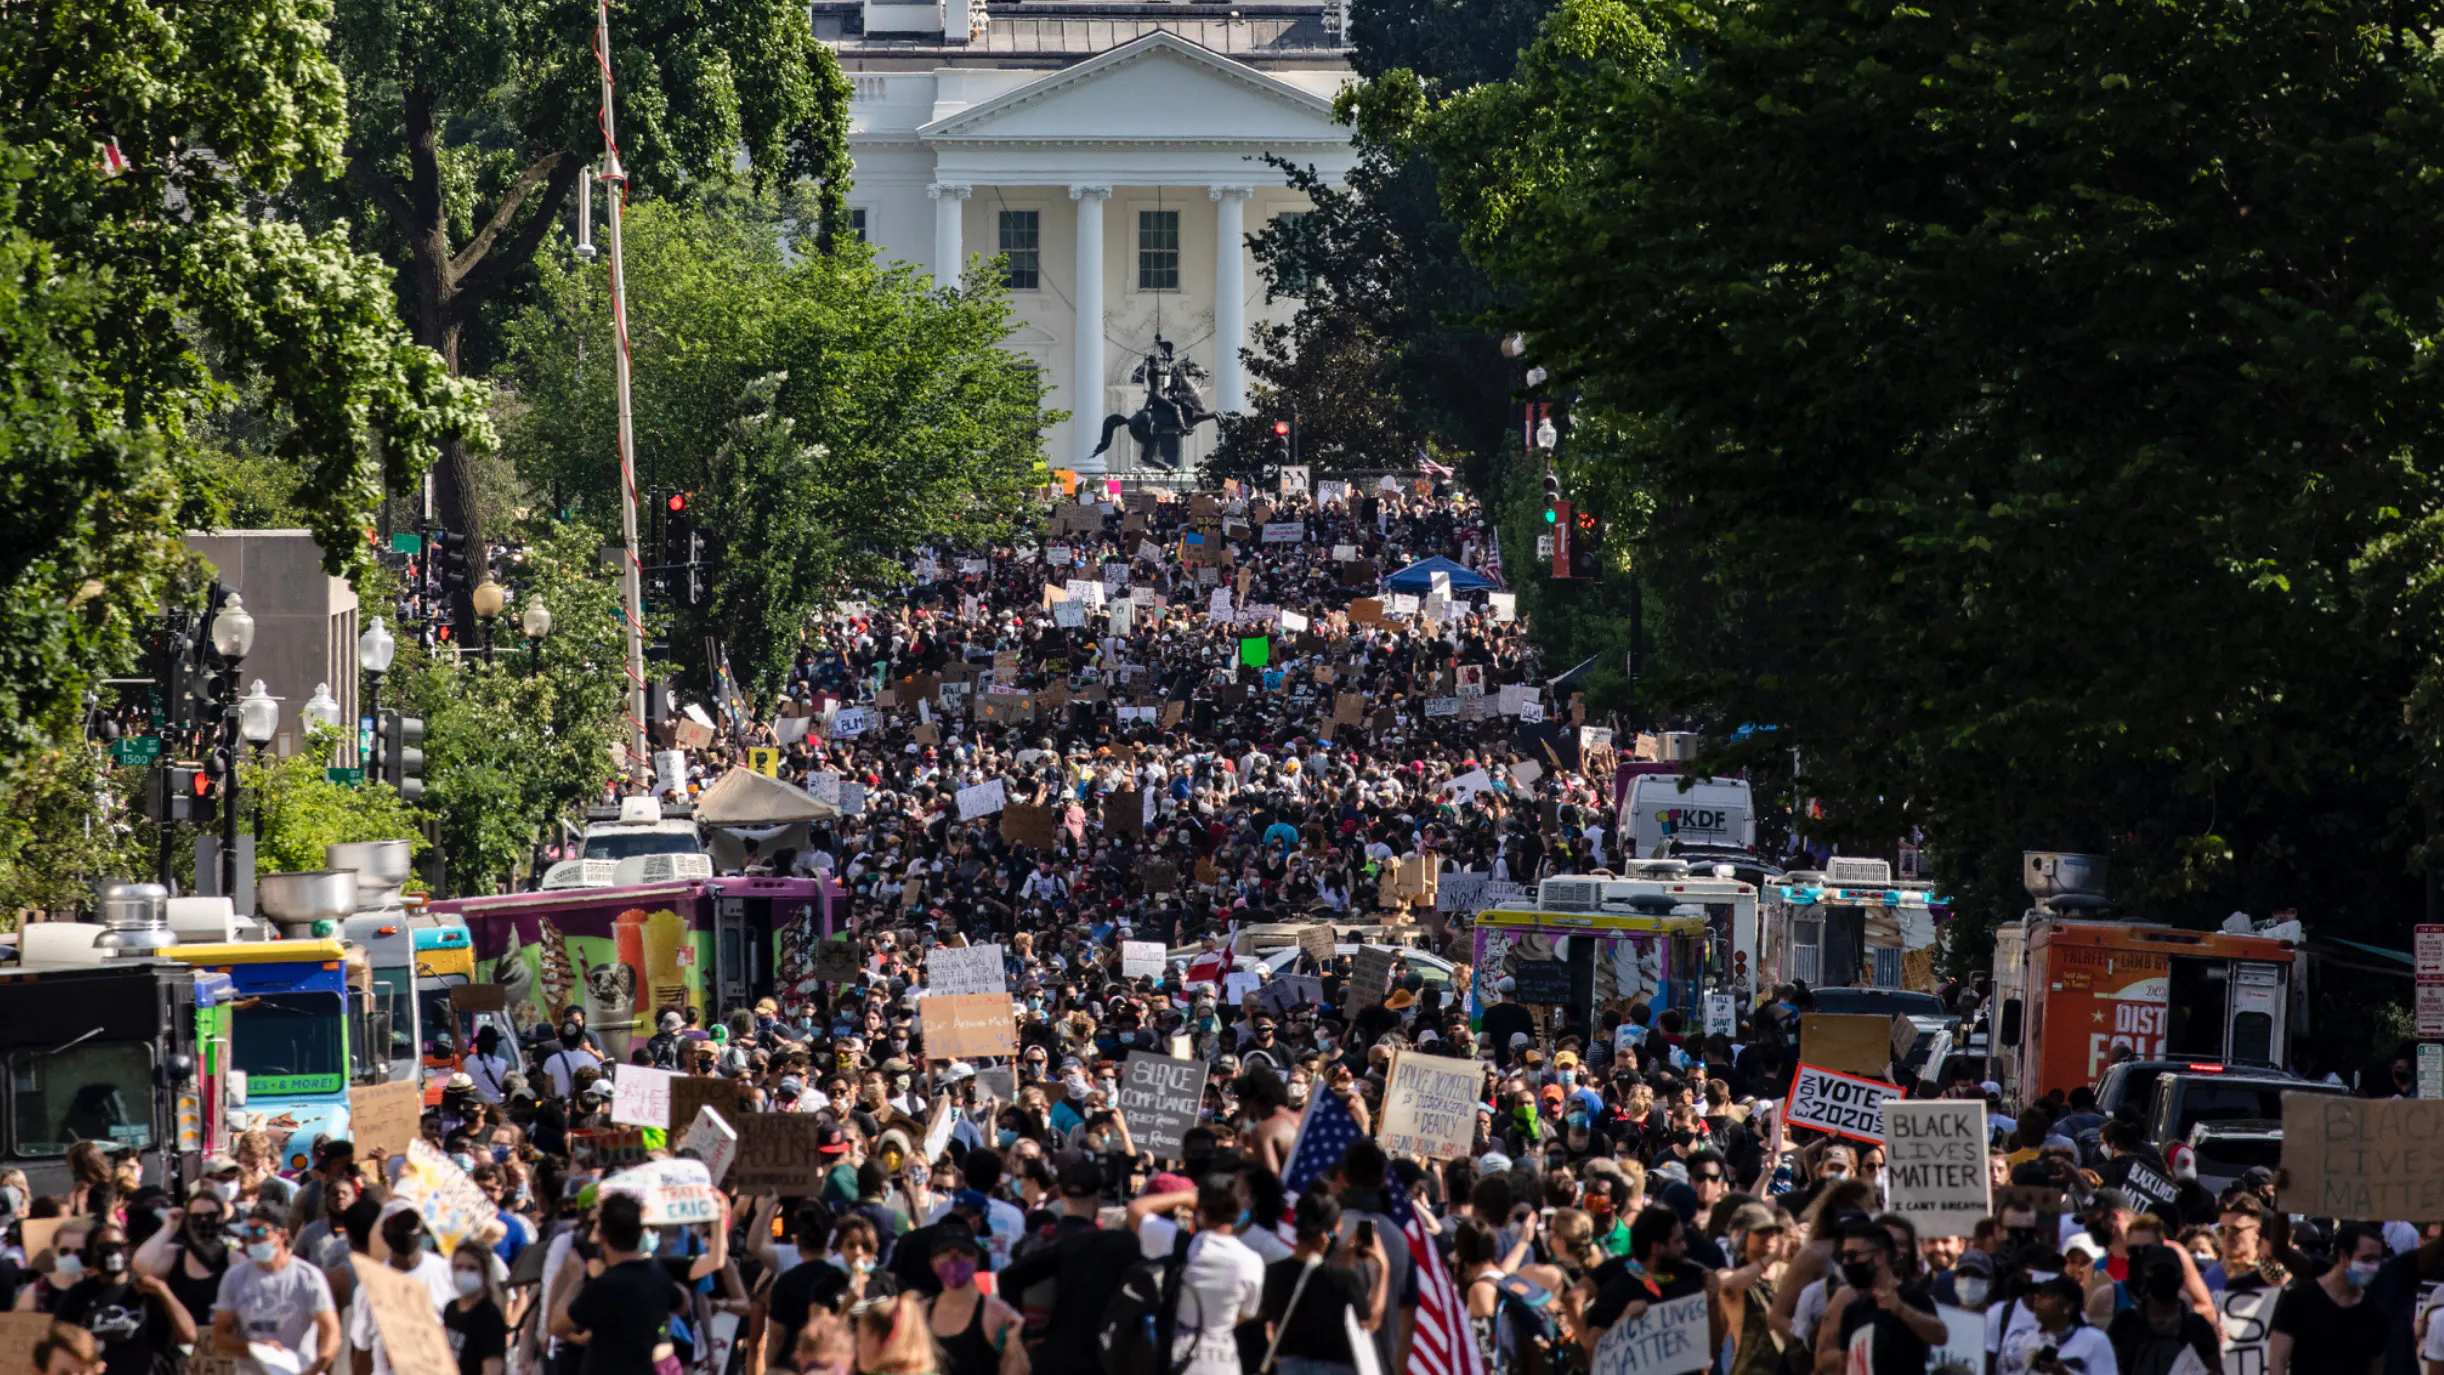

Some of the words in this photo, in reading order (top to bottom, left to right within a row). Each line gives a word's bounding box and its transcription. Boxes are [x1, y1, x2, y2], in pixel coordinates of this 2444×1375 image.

[1523, 705, 1541, 716] BLM
[841, 716, 865, 732] BLM
[123, 738, 132, 752] L
[123, 754, 149, 765] 1500
[1682, 809, 1726, 828] KDF
[2121, 953, 2151, 969] LAMB
[1711, 1017, 1732, 1028] SHUT
[291, 1078, 334, 1089] MORE!
[1131, 1060, 1197, 1093] SILENCE
[1396, 1063, 1432, 1093] POLICE
[1121, 1087, 1197, 1116] COMPLIANCE
[1798, 1074, 1817, 1109] NOV
[1818, 1075, 1882, 1110] VOTE
[1415, 1095, 1470, 1118] DISGRACEFUL
[1809, 1100, 1875, 1133] 2020
[1420, 1112, 1460, 1139] DEADLY
[1893, 1114, 1972, 1138] BLACK
[1891, 1142, 1977, 1161] LIVES
[1889, 1163, 1981, 1189] MATTER
[2128, 1162, 2158, 1190] BLACK
[2151, 1179, 2178, 1203] LIVES
[2323, 1178, 2444, 1214] MATTE
[1661, 1298, 1707, 1329] LIVES
